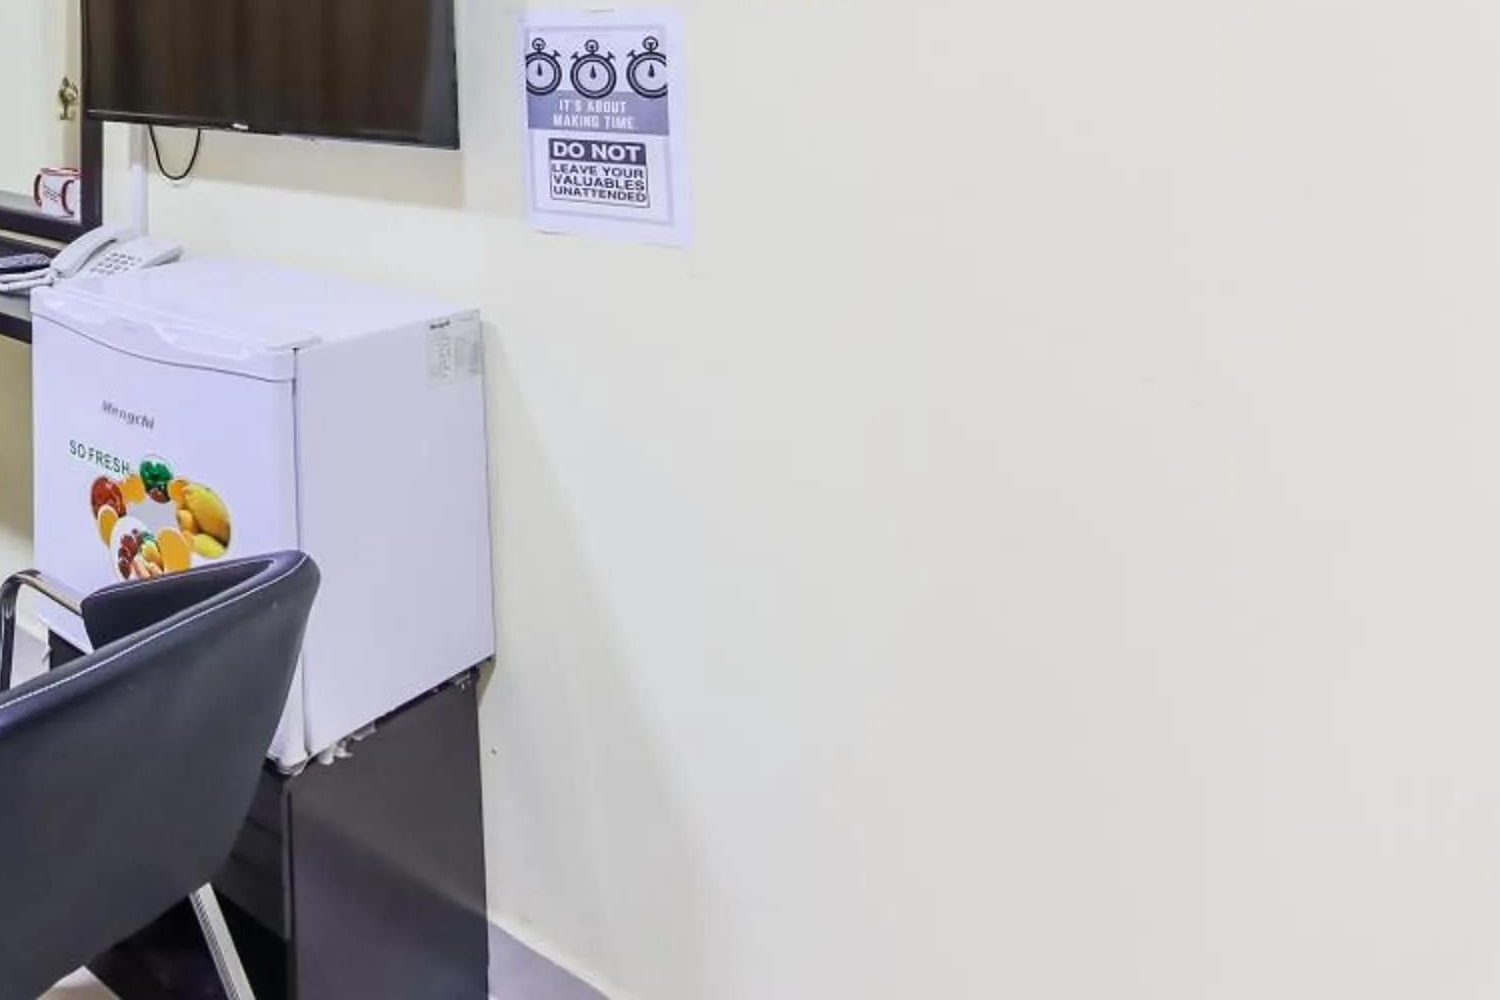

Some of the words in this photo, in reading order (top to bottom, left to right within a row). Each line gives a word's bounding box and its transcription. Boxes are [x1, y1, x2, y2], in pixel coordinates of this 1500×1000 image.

[587, 100, 627, 114] ABOUT
[552, 113, 600, 128] MAKING
[553, 141, 585, 159] DO
[591, 143, 641, 163] NOT
[551, 163, 598, 175] LEAVE
[602, 165, 644, 179] YOUR
[553, 174, 645, 191] VALUABLES
[553, 185, 647, 203] UNATTENDED
[68, 439, 87, 459] SO
[87, 446, 130, 475] FRESH
